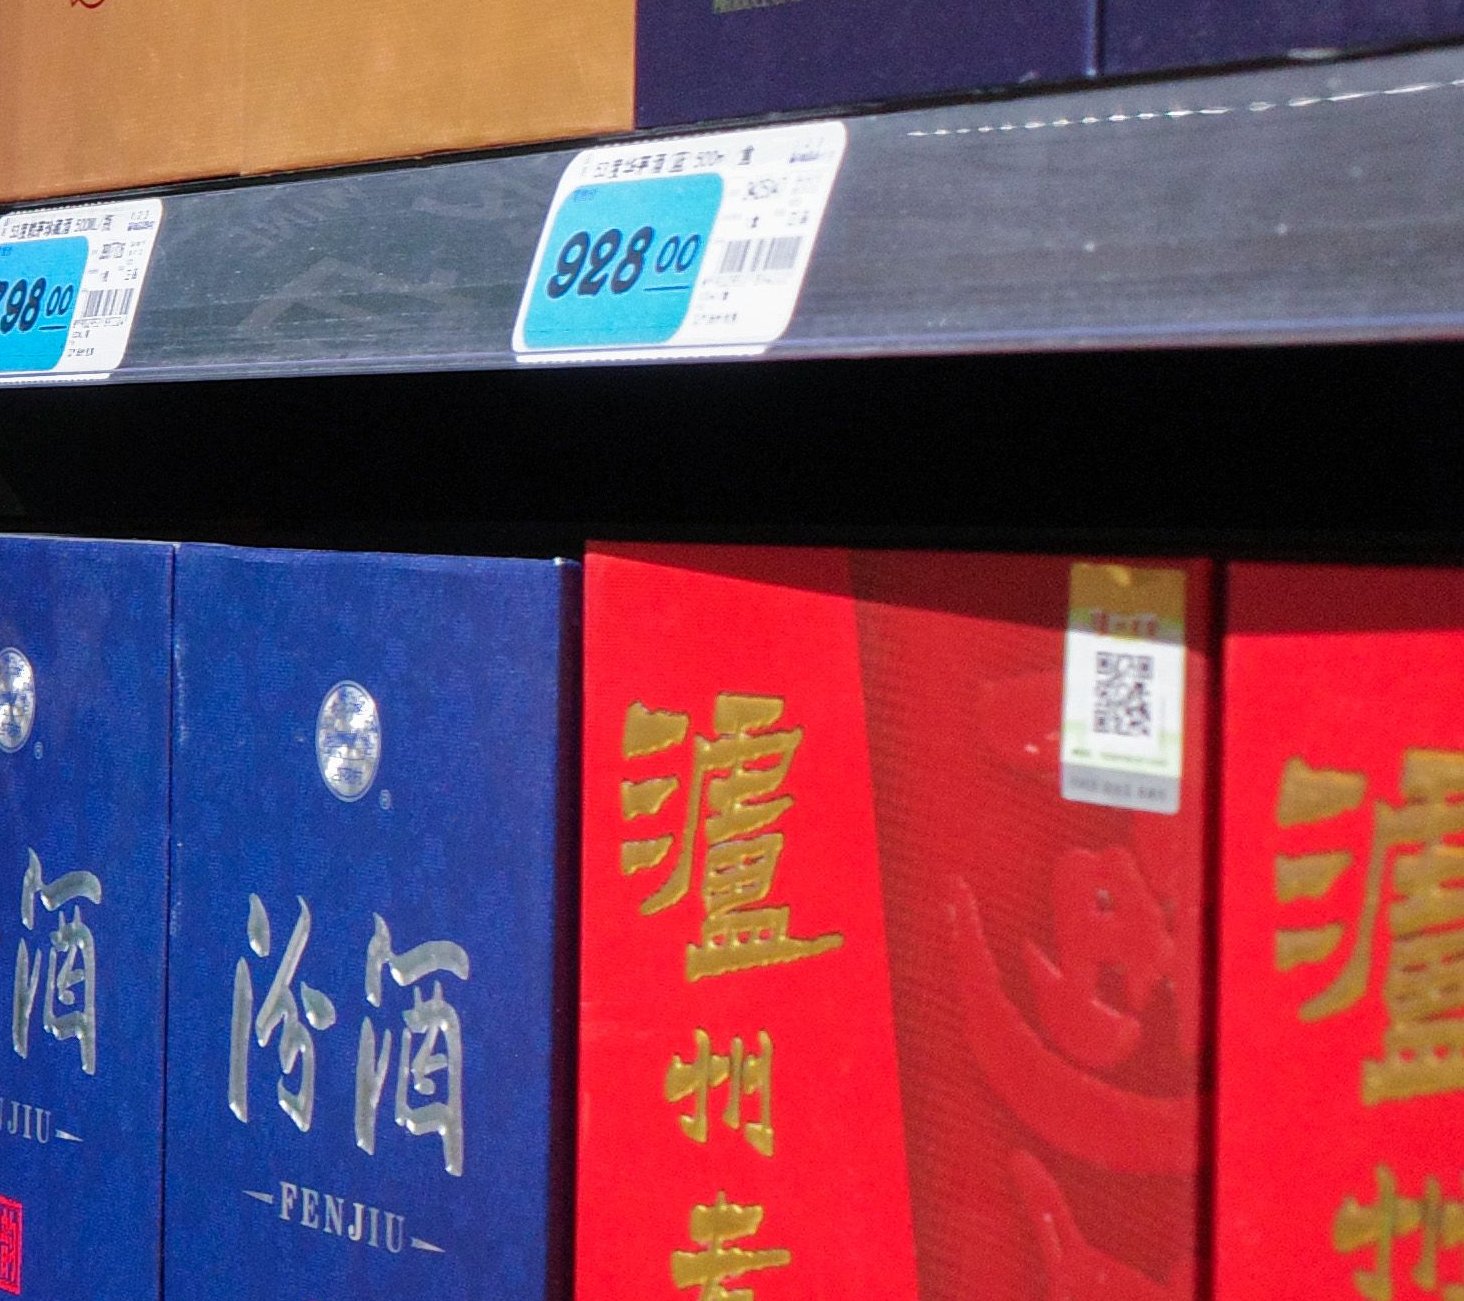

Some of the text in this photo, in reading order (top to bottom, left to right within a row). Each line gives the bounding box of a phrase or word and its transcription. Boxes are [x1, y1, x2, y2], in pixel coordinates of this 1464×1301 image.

[45, 283, 75, 318] 00
[227, 891, 471, 1178] 汾酒
[278, 1182, 407, 1255] FENJIU
